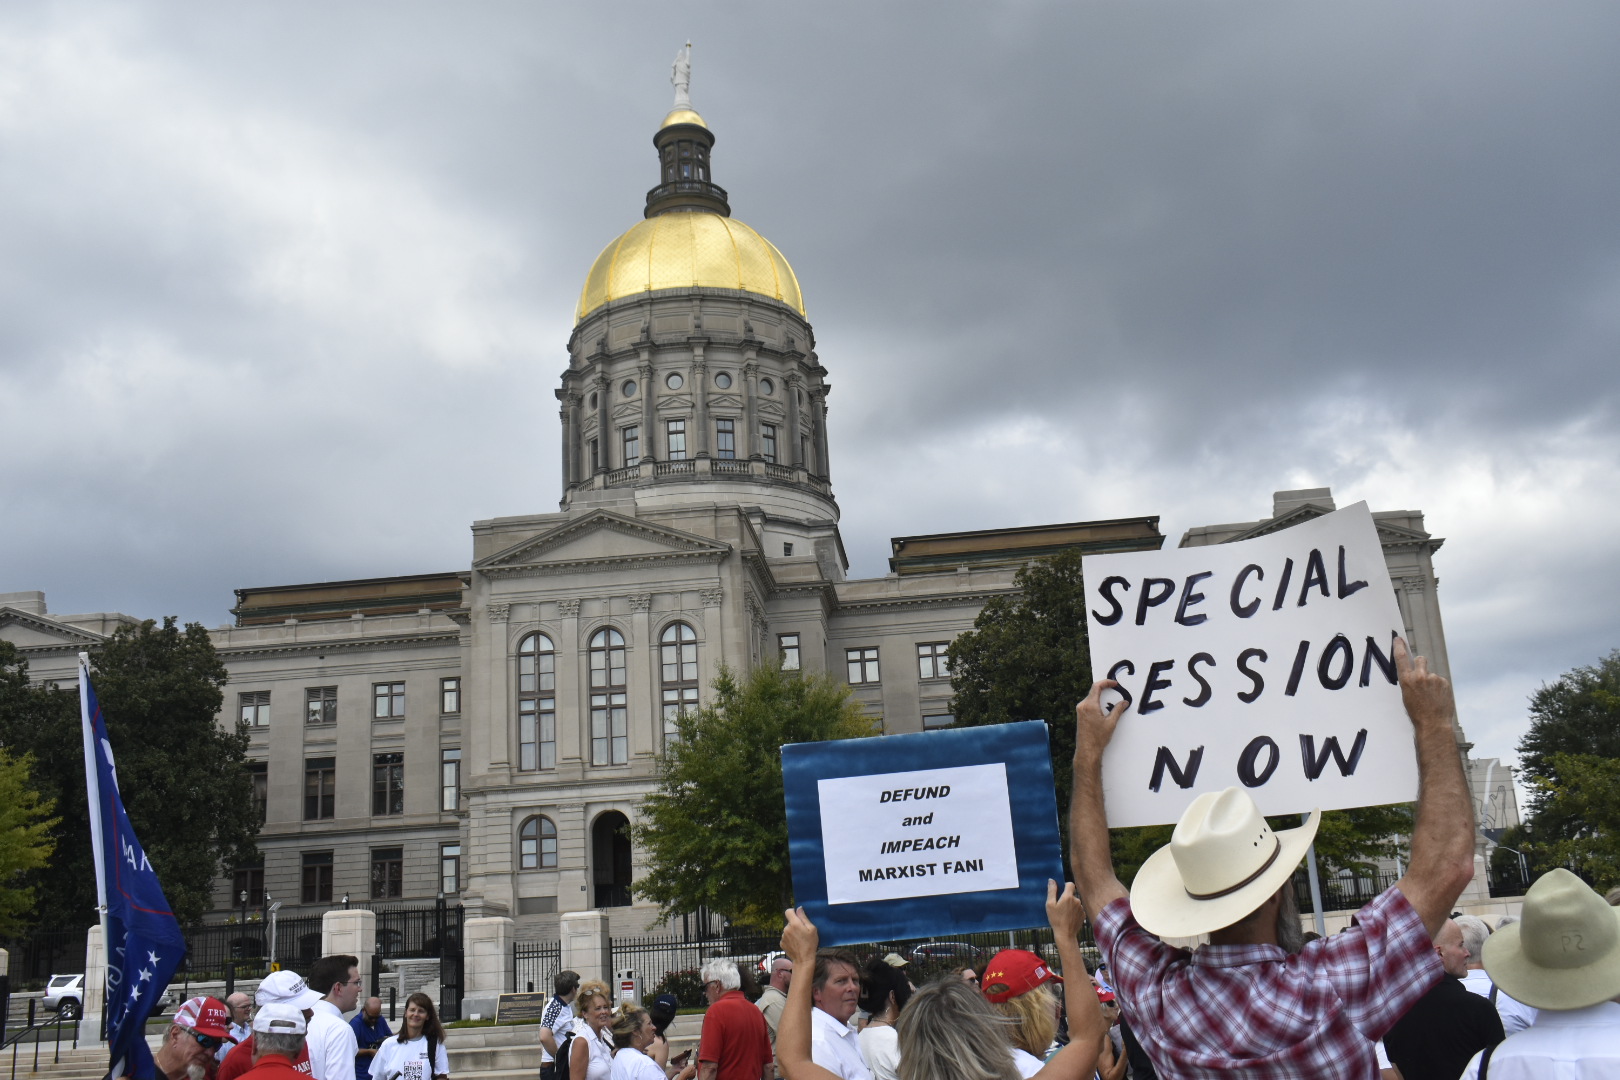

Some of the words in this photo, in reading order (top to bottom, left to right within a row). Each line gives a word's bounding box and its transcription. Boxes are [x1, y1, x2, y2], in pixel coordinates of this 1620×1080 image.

[1091, 545, 1369, 626] SPECIAL
[1105, 629, 1399, 715] SESSION
[1148, 728, 1368, 793] NOW
[880, 785, 951, 803] DEFUND
[902, 812, 934, 827] and
[880, 835, 961, 855] IMPEACH
[859, 863, 937, 882] MARXIST
[943, 859, 984, 875] FANI
